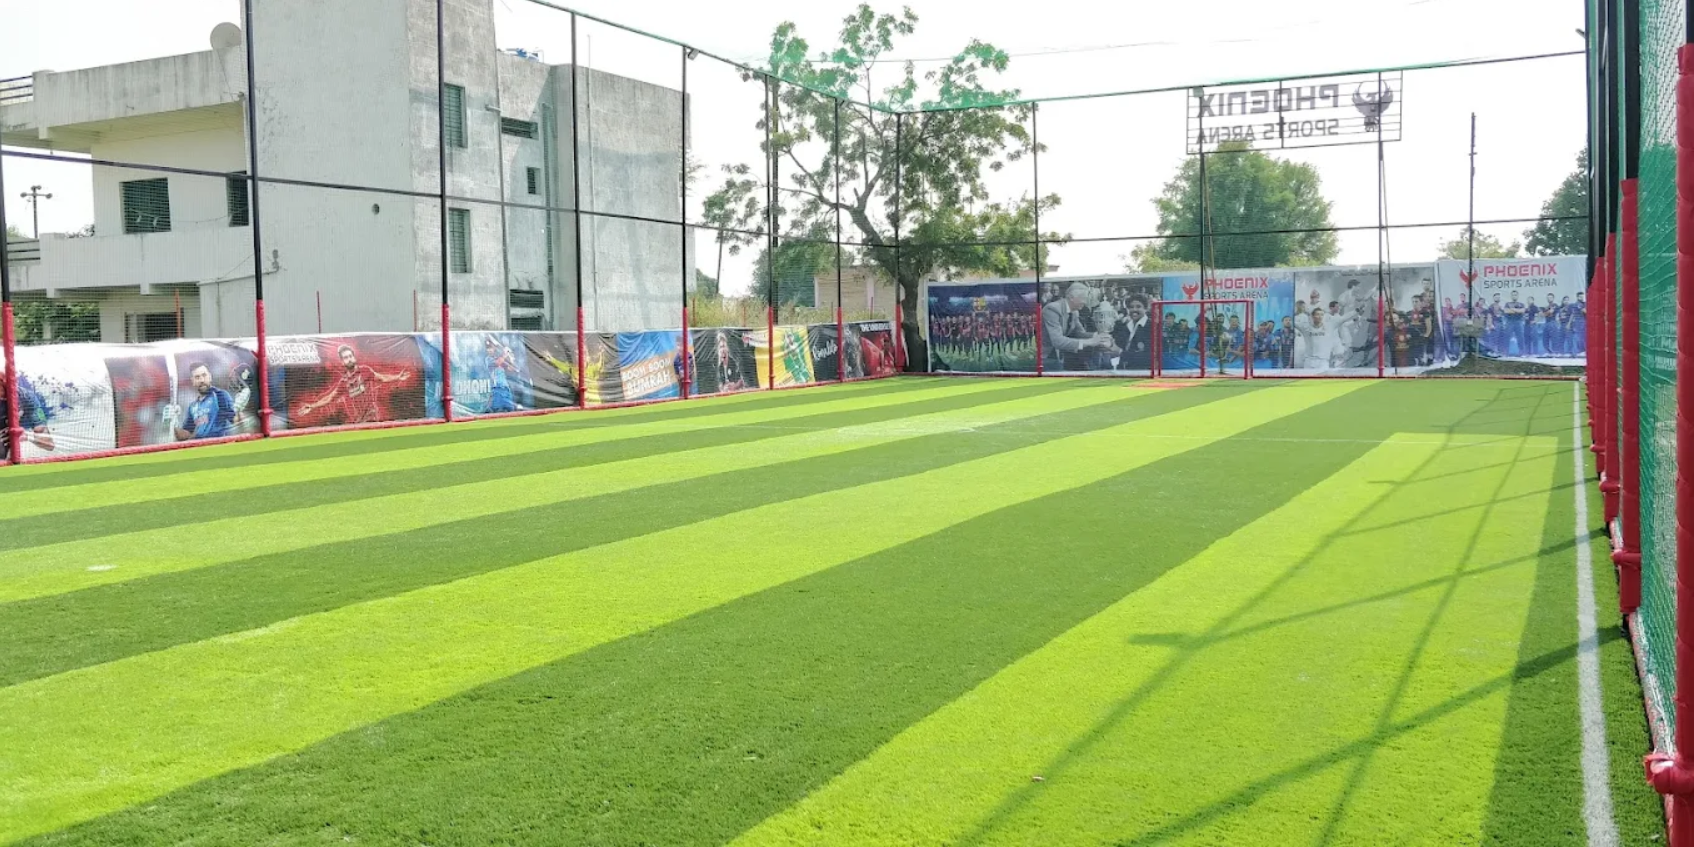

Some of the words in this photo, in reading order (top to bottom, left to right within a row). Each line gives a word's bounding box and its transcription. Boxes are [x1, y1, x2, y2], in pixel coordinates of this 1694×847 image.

[1484, 263, 1557, 278] PHOENIX
[1204, 277, 1269, 290] PHOENIX
[1484, 278, 1523, 289] SPORTS
[1524, 277, 1557, 288] ARENA
[1203, 291, 1237, 300] SPORTS
[1239, 291, 1269, 299] ARENA
[267, 344, 317, 354] PHOENIX
[621, 366, 646, 382] BOOM
[648, 357, 671, 373] BOOM
[455, 378, 491, 395] DHONI
[627, 369, 671, 395] BUMRAH
